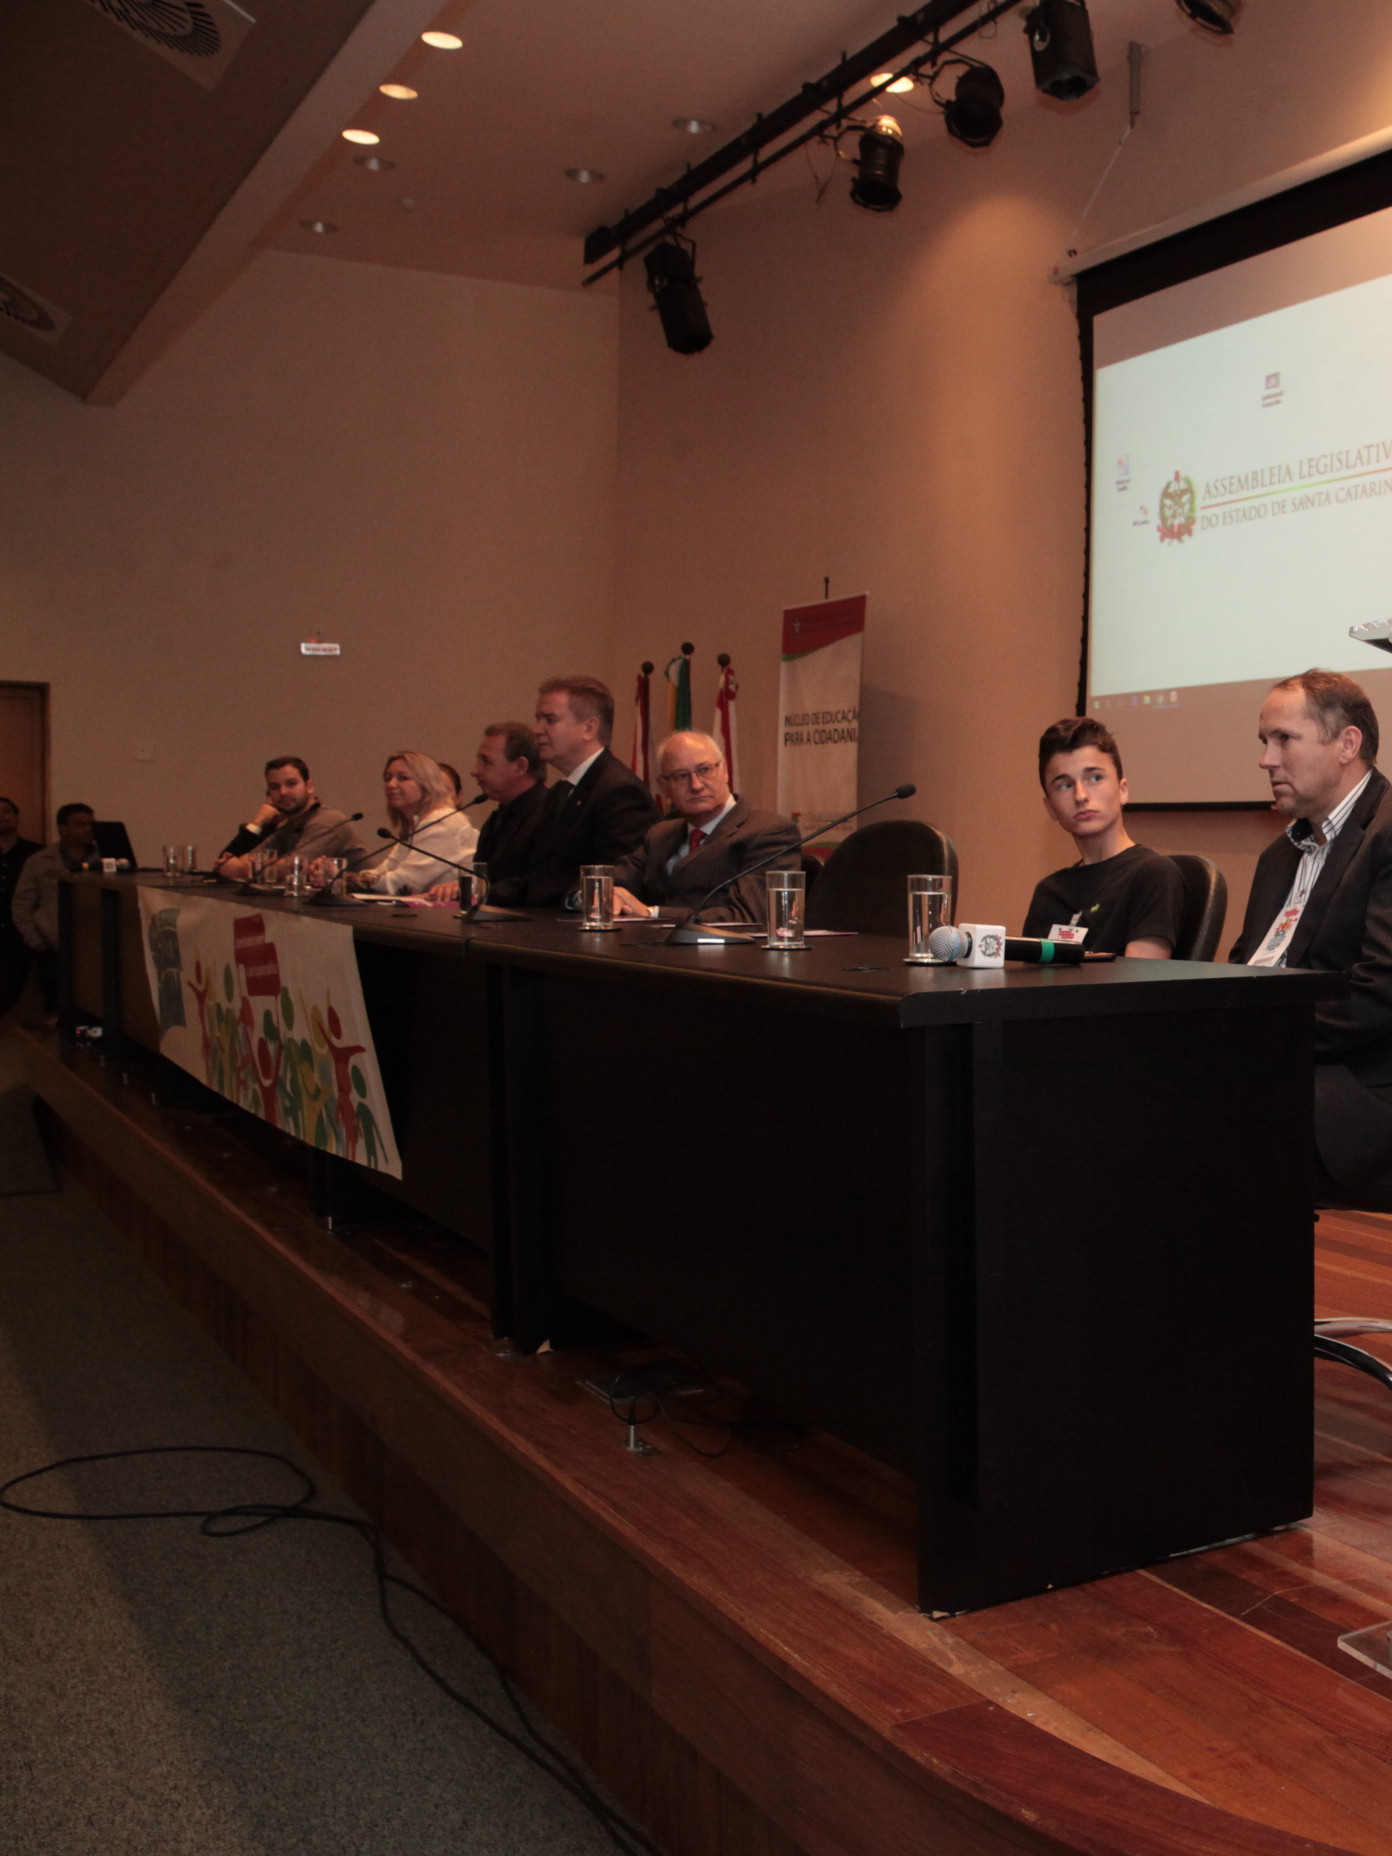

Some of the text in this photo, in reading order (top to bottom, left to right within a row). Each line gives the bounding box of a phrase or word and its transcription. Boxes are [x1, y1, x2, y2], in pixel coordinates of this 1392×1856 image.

[1202, 463, 1294, 500] ASSEMBLEIA
[1200, 513, 1219, 530] DO
[1222, 503, 1267, 527] ESTADO
[1271, 499, 1288, 517] DE
[1290, 491, 1333, 513] SANTA
[822, 706, 858, 725] EDUCAÇÃ
[813, 728, 858, 745] CIDADANI
